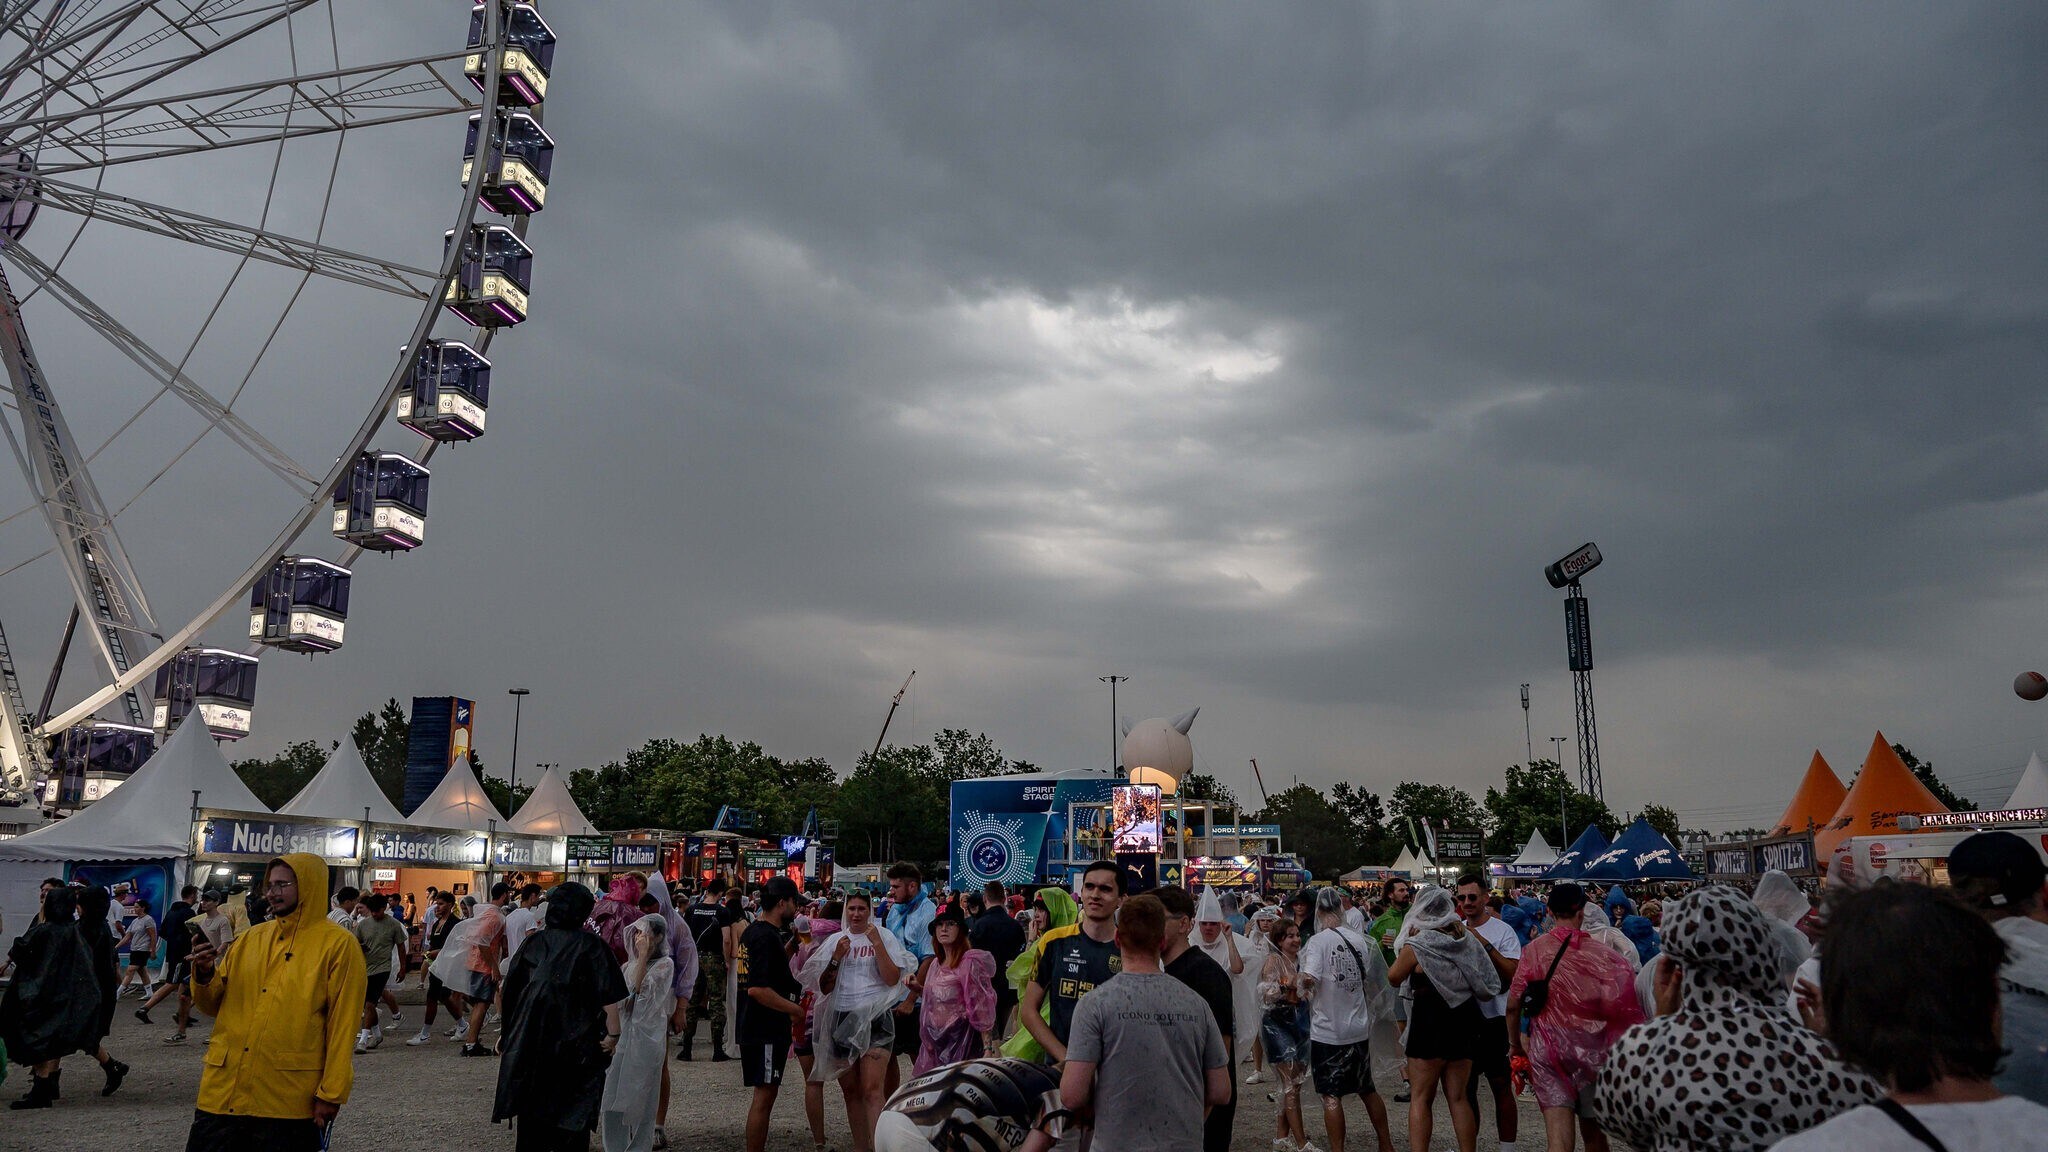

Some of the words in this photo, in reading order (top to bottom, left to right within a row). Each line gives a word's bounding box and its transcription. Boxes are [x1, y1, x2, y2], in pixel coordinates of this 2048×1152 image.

[1563, 551, 1592, 575] Egger
[1022, 793, 1055, 801] STAGE
[1920, 814, 1949, 826] FLAME
[1950, 811, 1990, 825] GRILLING
[1991, 809, 2018, 822] SINCE
[2022, 808, 2044, 821] 1954
[501, 842, 530, 864] Pizza
[617, 846, 624, 864] &
[625, 846, 655, 864] Italiana
[1713, 850, 1746, 874] SPRITZER
[1763, 842, 1805, 872] SPRITZER
[1068, 963, 1079, 973] SM
[1118, 1012, 1150, 1020] ICONO
[1153, 1013, 1198, 1022] COUTURE
[906, 1096, 925, 1107] MEGA
